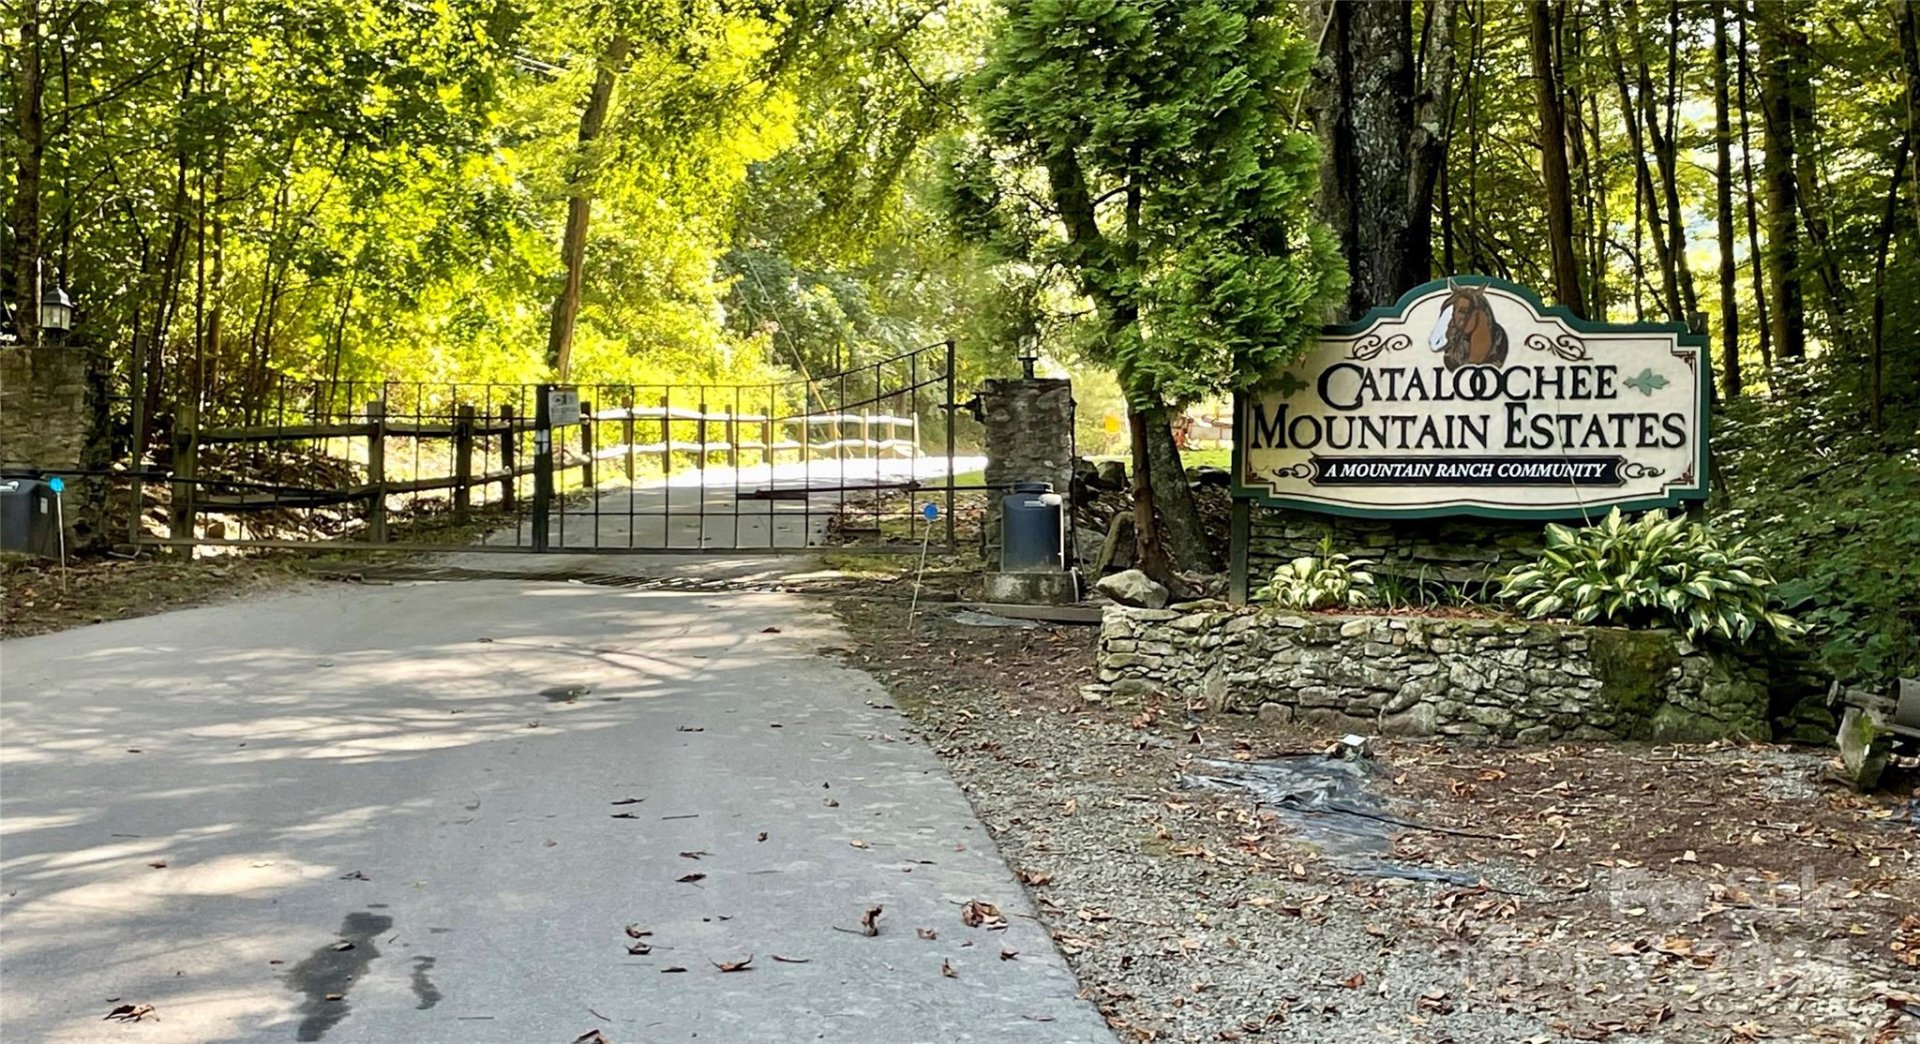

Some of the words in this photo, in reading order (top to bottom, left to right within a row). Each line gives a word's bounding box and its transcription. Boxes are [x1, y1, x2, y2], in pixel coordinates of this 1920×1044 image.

[1317, 362, 1618, 410] CATALOOCHEE
[1251, 403, 1490, 450] MOUNTAIN
[1504, 402, 1687, 449] ESTATES
[1325, 463, 1337, 478] A
[1340, 463, 1431, 478] MOUNTAIN
[1435, 463, 1493, 478] RANCH
[1498, 463, 1606, 478] COMMUNITY
